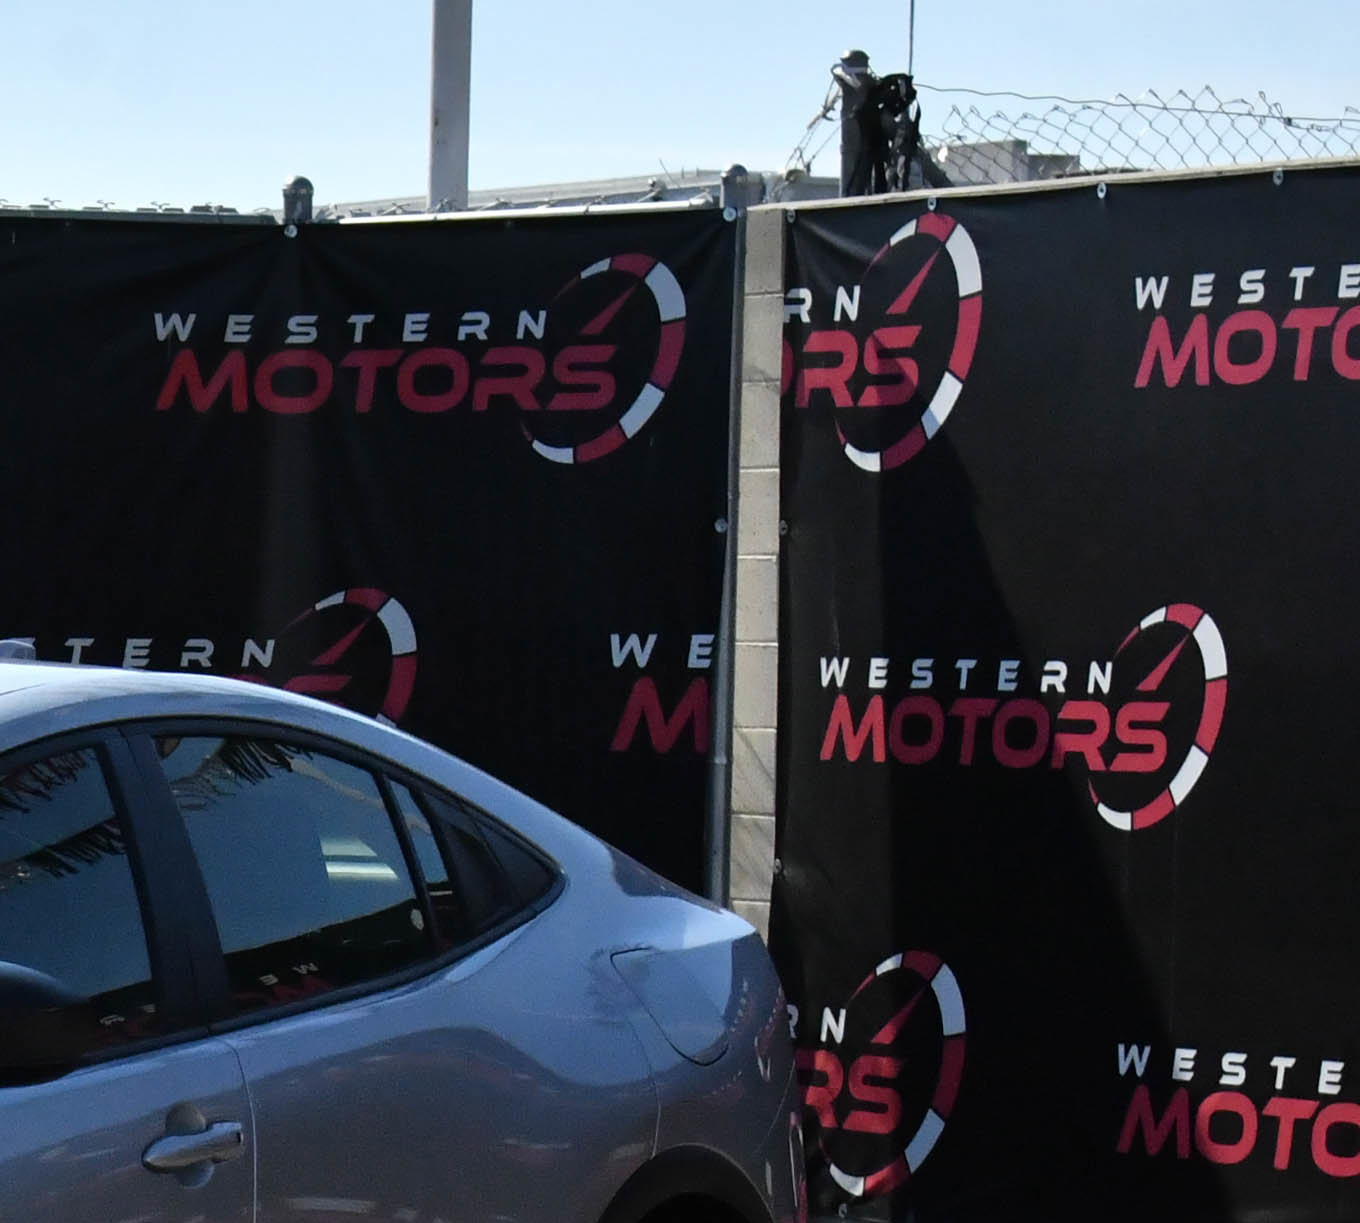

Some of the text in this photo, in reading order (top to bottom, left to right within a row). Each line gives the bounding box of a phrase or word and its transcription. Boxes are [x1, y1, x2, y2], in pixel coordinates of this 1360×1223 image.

[1135, 263, 1360, 310] WESTE
[154, 310, 546, 344] WESTERN
[156, 343, 617, 414] MOTORS
[819, 656, 1112, 695] WESTERN
[819, 692, 1171, 773] MOTORS
[1117, 1043, 1345, 1095] WESTE
